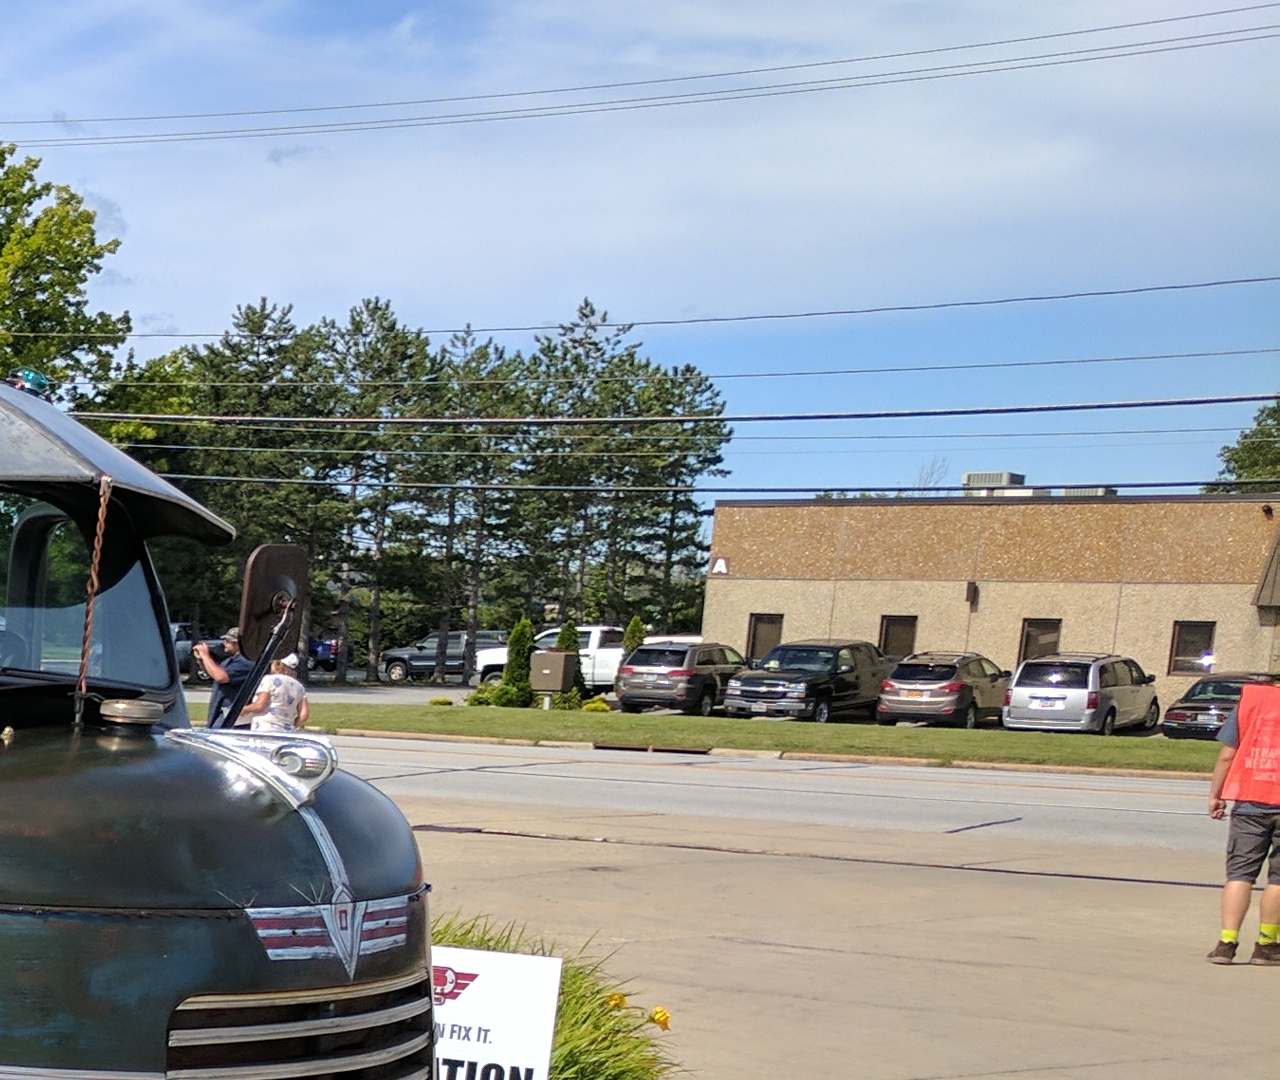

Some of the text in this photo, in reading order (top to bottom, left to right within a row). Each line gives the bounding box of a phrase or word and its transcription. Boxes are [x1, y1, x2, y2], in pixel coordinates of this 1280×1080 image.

[712, 557, 729, 575] A
[449, 1023, 473, 1042] FIX
[476, 1026, 492, 1044] IT.
